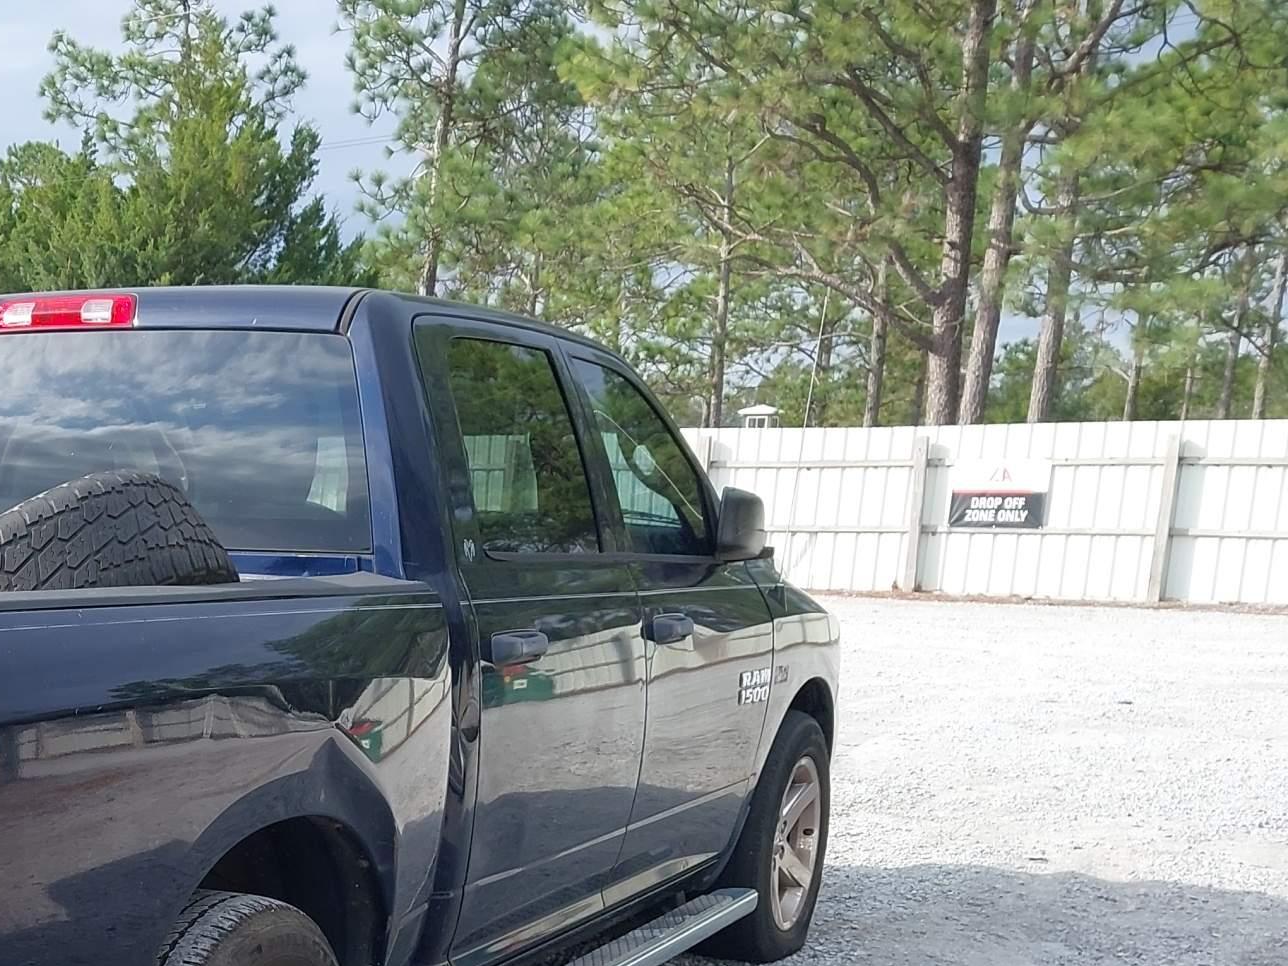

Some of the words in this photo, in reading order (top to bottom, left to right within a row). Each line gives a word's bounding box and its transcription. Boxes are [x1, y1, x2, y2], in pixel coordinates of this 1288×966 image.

[971, 497, 1002, 509] DROP
[1004, 497, 1026, 509] OFF
[964, 510, 996, 522] ZONE
[997, 510, 1028, 522] ONLY
[740, 667, 772, 688] RAM
[738, 686, 770, 705] 1500
